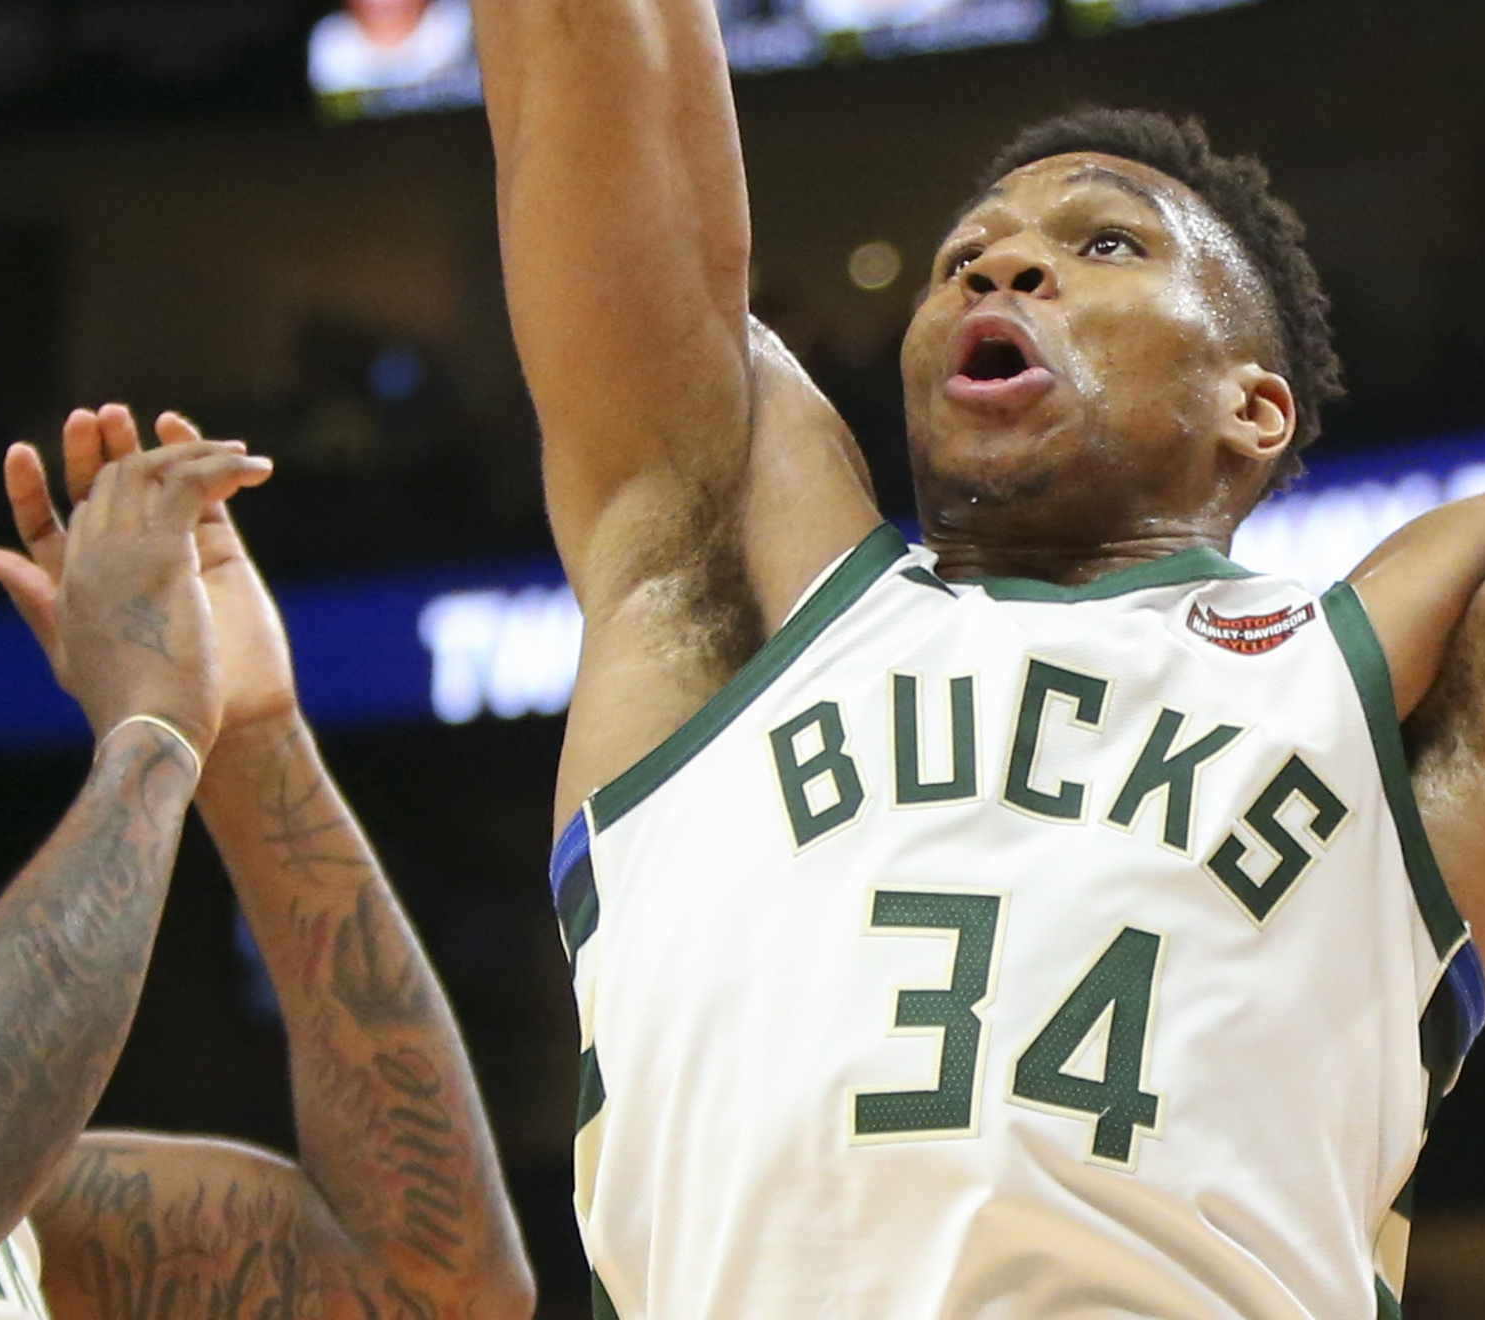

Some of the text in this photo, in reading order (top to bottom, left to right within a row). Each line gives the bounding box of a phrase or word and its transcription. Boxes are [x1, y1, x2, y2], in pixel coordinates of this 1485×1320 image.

[1192, 608, 1308, 641] HARLEY-DAVIDSON
[768, 653, 1354, 930] BUCKS
[846, 882, 1170, 1172] 34
